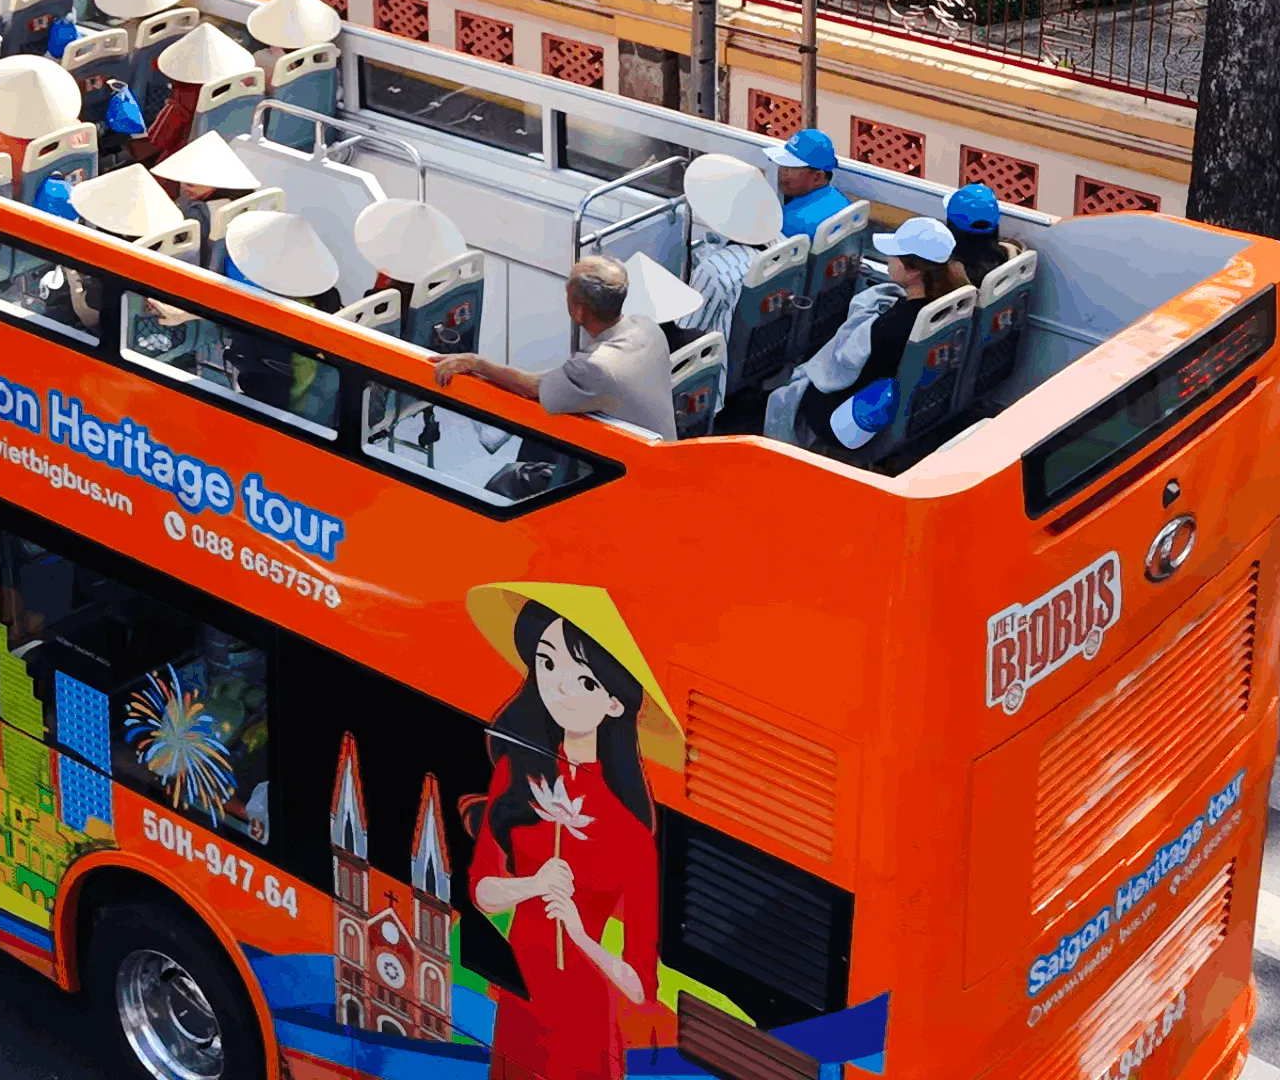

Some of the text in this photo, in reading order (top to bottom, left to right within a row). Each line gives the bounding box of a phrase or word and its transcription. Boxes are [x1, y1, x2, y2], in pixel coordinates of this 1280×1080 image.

[51, 393, 232, 509] Heritage
[244, 476, 344, 556] tour
[192, 524, 341, 608] 088 6657579
[143, 808, 298, 918] 50H-947.64
[1027, 907, 1111, 996] Saigon
[1115, 818, 1204, 921] Heritage
[1209, 770, 1245, 825] tour
